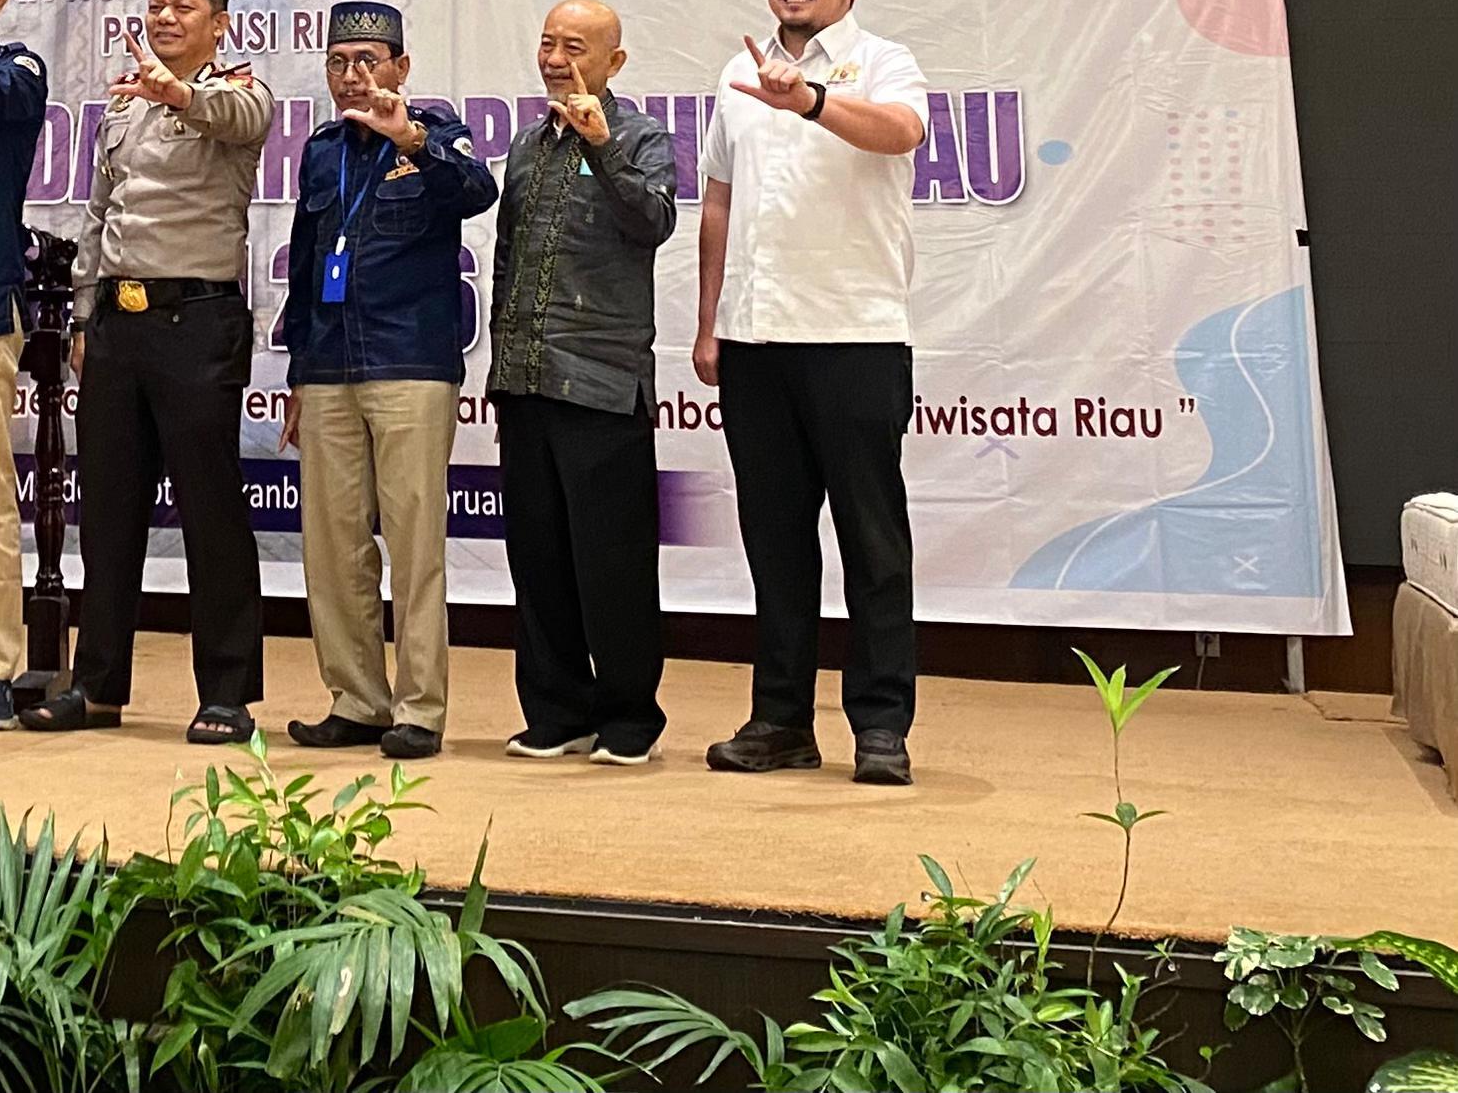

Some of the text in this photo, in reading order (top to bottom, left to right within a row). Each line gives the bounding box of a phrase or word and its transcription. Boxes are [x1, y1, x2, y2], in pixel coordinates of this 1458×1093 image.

[104, 11, 277, 54] PRNSI
[913, 395, 1058, 437] iwisata
[1073, 396, 1163, 438] Riau
